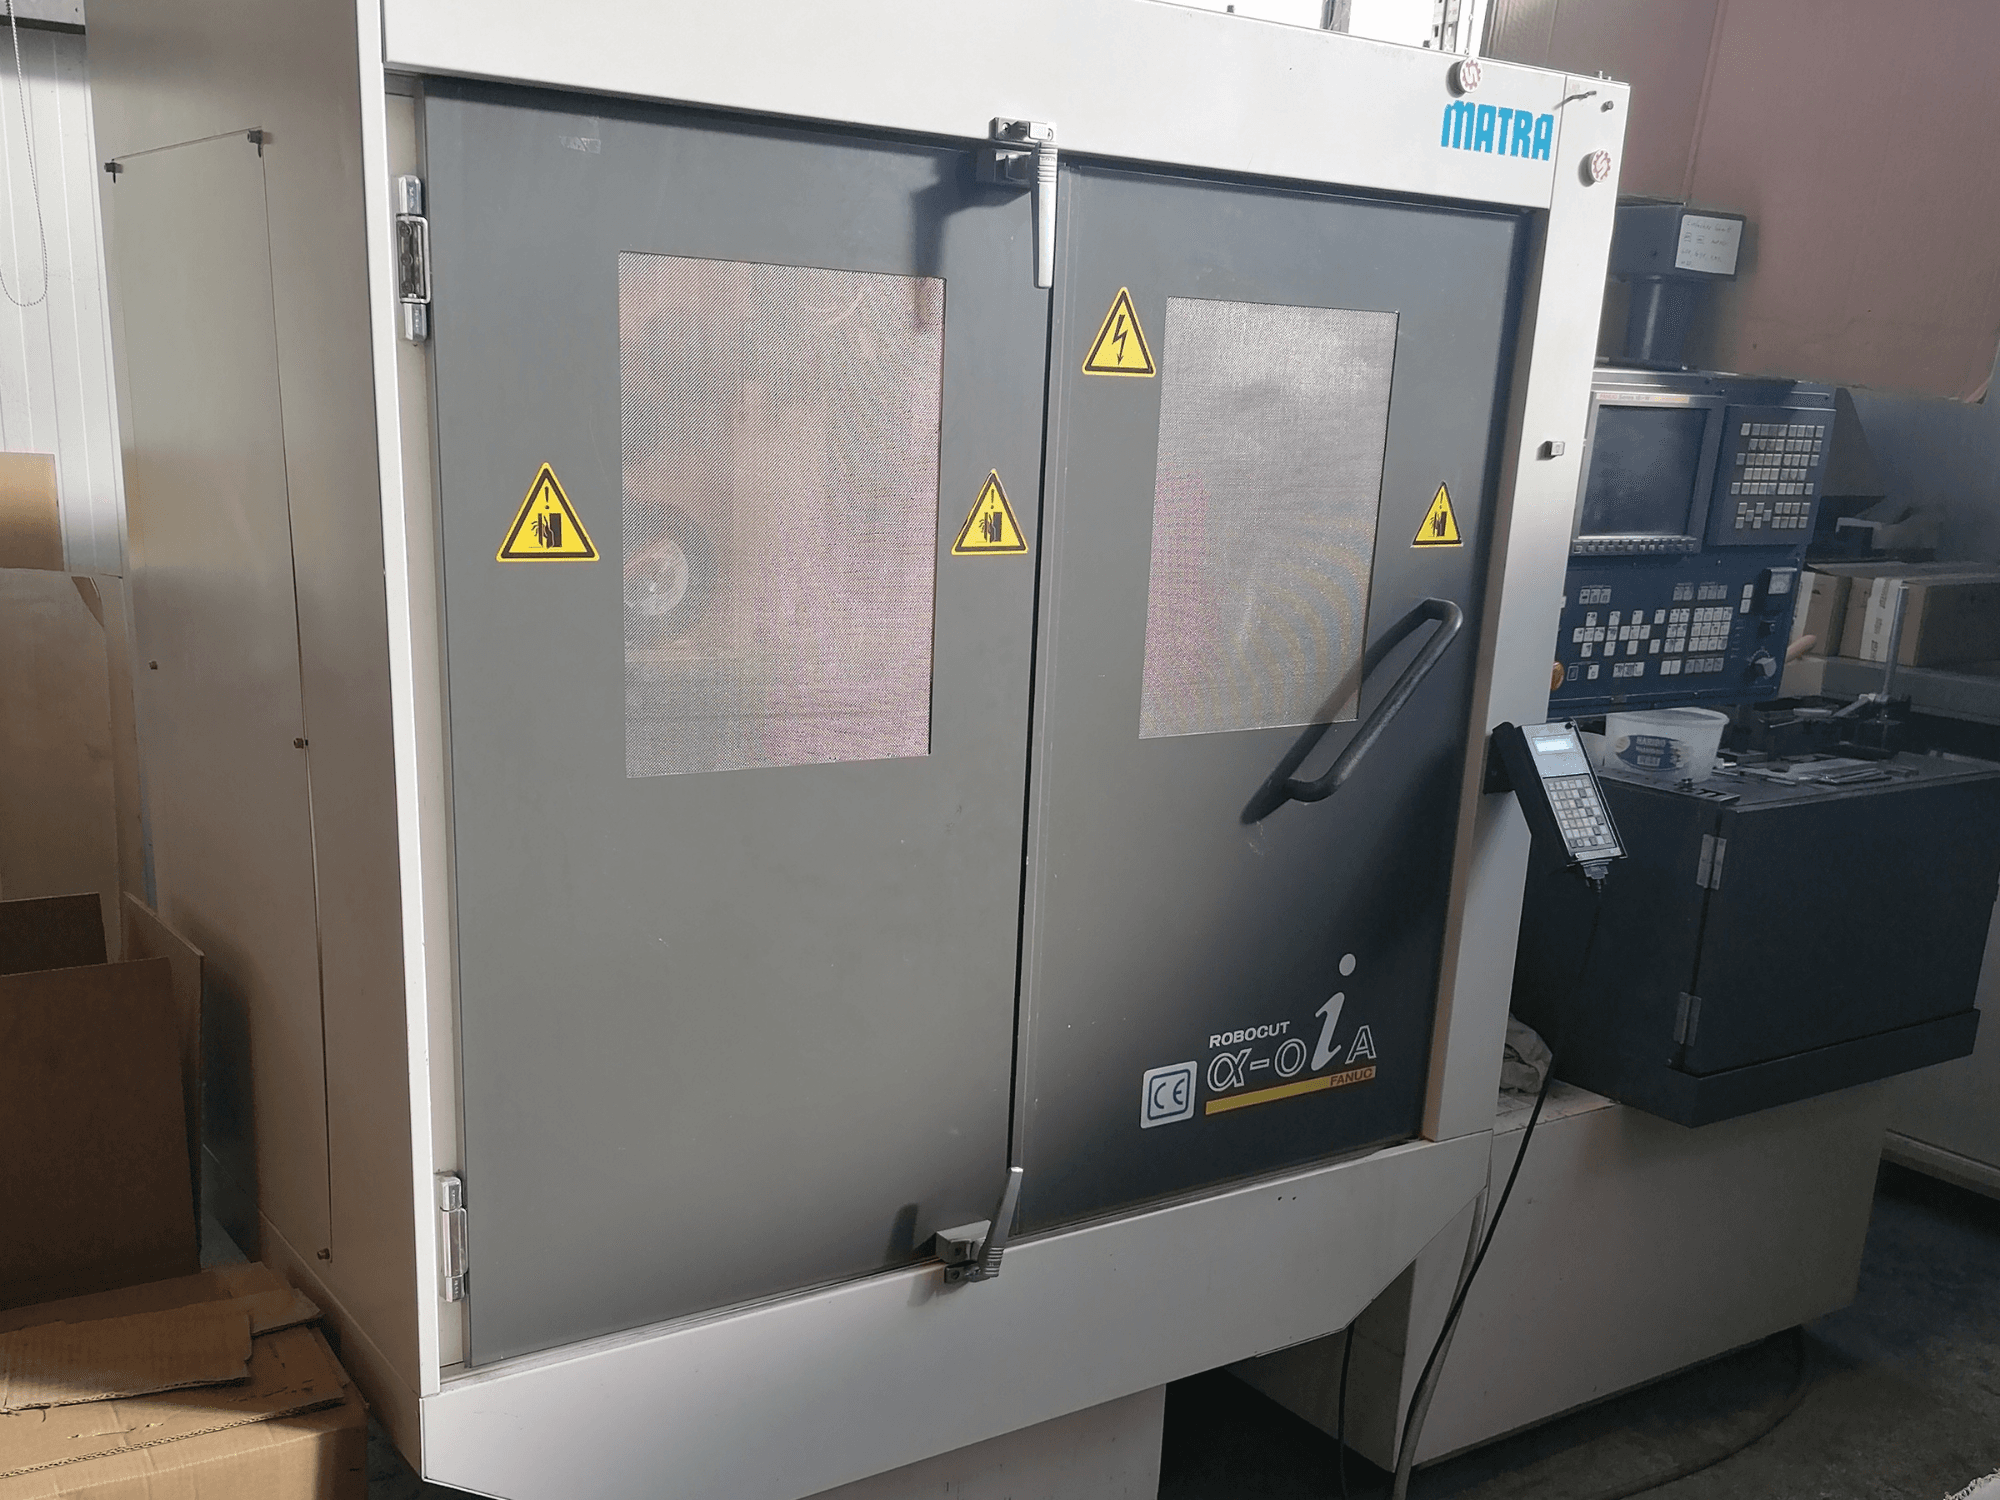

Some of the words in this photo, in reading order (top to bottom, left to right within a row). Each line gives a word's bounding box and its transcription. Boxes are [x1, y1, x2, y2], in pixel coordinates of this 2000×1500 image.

[1441, 100, 1554, 161] MATRA
[1209, 1021, 1290, 1049] ROBOCUT
[1330, 1068, 1373, 1087] FANUC
